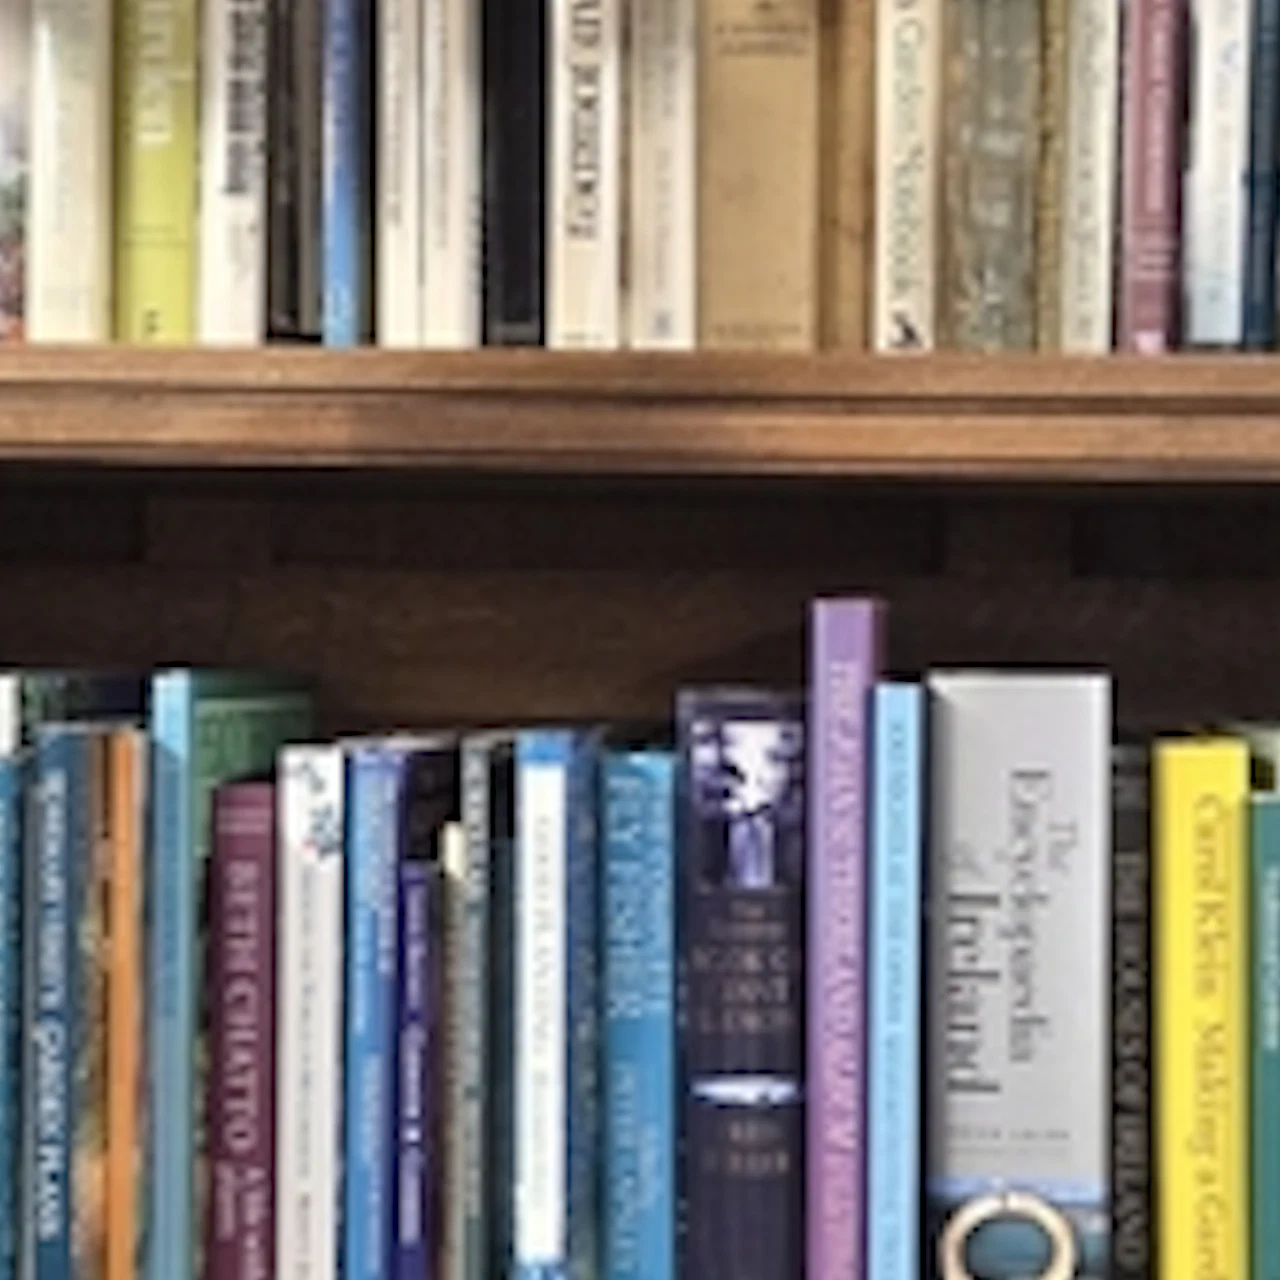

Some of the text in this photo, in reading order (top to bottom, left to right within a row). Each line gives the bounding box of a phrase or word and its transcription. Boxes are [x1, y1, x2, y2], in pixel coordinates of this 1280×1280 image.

[608, 774, 643, 1018] FLY FISHER
[1048, 818, 1080, 876] The
[1193, 792, 1232, 999] Carol Klein
[222, 858, 260, 1154] BETH CHATTO
[946, 890, 1003, 1095] Ireland
[1184, 1016, 1230, 1159] Making
[1194, 1169, 1220, 1187] a
[1116, 1113, 1145, 1273] IRELAND
